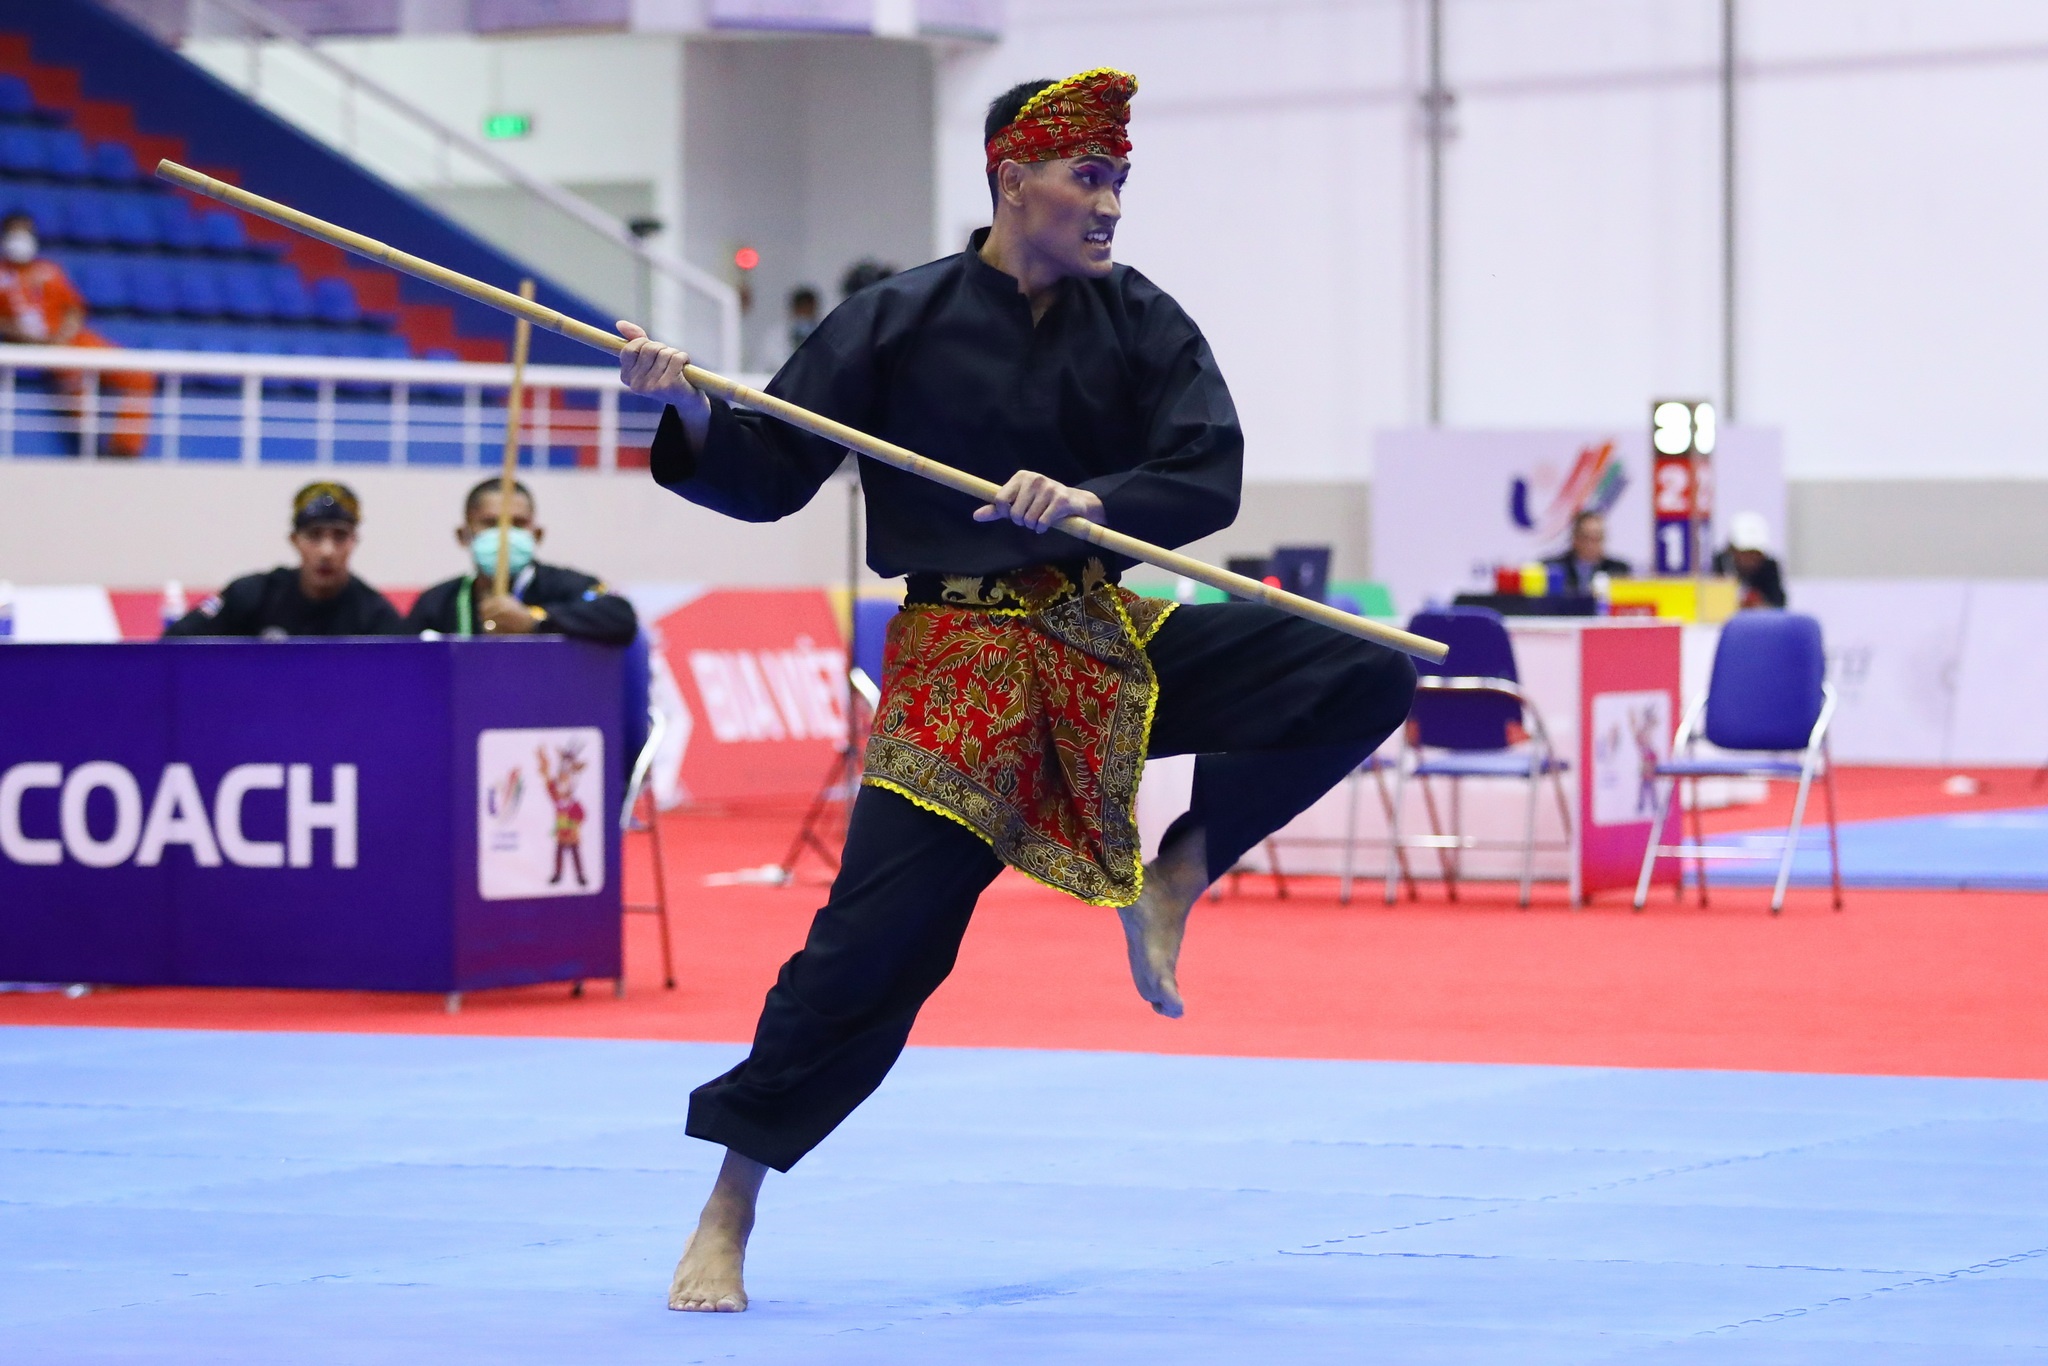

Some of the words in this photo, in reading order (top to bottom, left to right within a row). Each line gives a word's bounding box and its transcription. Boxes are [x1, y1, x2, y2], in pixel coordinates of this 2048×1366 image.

[1658, 463, 1688, 512] 2
[1661, 523, 1683, 571] 1
[0, 760, 358, 869] COACH
